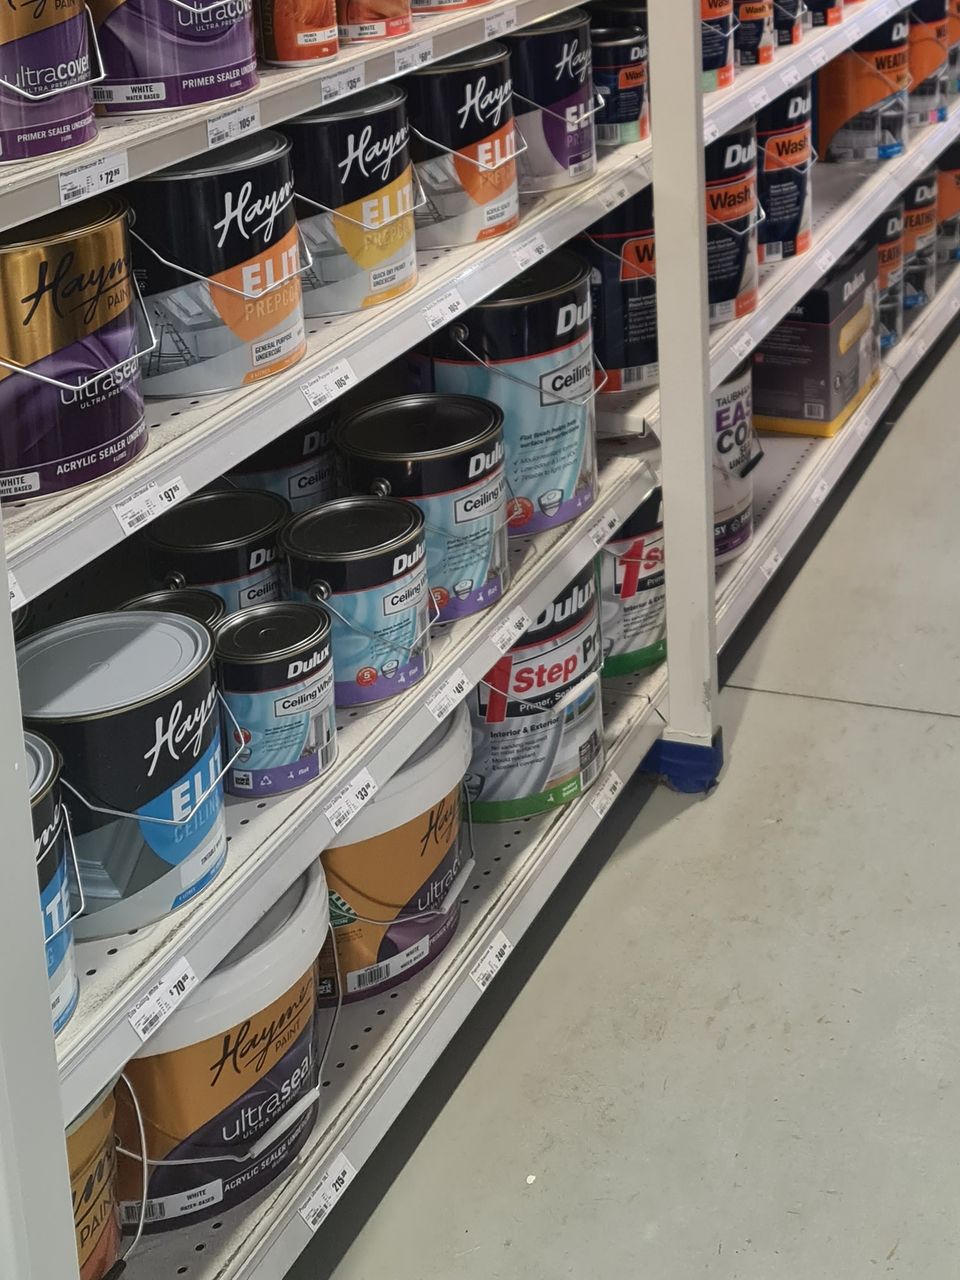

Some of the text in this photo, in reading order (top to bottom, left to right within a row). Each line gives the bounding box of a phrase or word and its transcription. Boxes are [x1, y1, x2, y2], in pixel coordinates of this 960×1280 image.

[130, 84, 154, 96] WHITE
[182, 68, 241, 90] PRIMER SEALER
[17, 124, 71, 143] PRIMER SEALER
[362, 183, 412, 231] ELIT
[242, 244, 299, 300] ELIT
[56, 440, 127, 476] ACRYLIC SEALER
[13, 483, 33, 494] BASED
[463, 490, 499, 513] Ceiling
[391, 584, 421, 607] Ceiling
[287, 644, 331, 680] Dulux
[512, 653, 578, 694] Step
[282, 691, 317, 710] Ceiling
[490, 729, 521, 739] Interior
[529, 716, 561, 732] Exterior
[222, 1041, 314, 1143] ultraseal
[223, 1145, 287, 1193] ACRYLIC SEALER
[186, 1188, 207, 1202] WHITE
